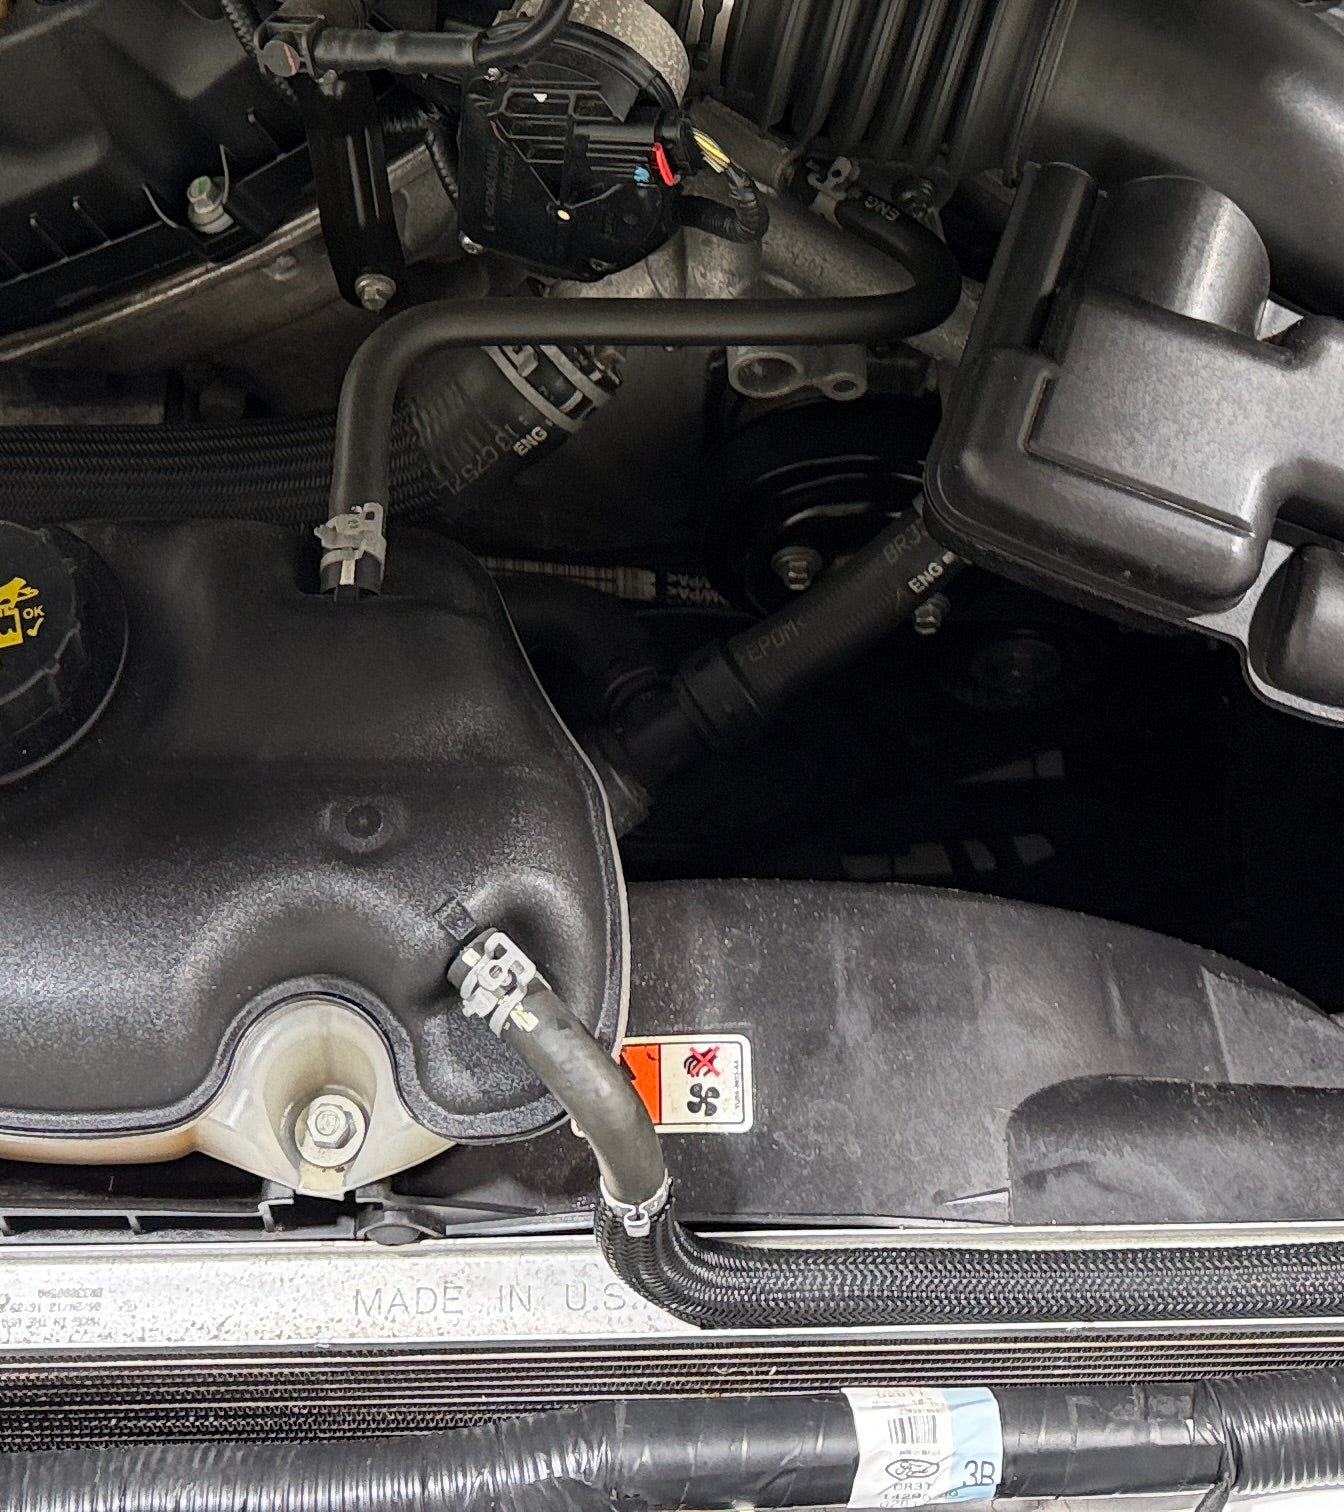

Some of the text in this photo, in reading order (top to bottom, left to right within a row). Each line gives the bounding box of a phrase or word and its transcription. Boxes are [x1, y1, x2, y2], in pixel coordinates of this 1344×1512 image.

[513, 425, 548, 457] ENG
[907, 560, 944, 595] ENG
[22, 604, 46, 620] OK
[354, 1284, 463, 1318] MADE
[499, 1284, 532, 1314] IN
[964, 1460, 996, 1487] 3B
